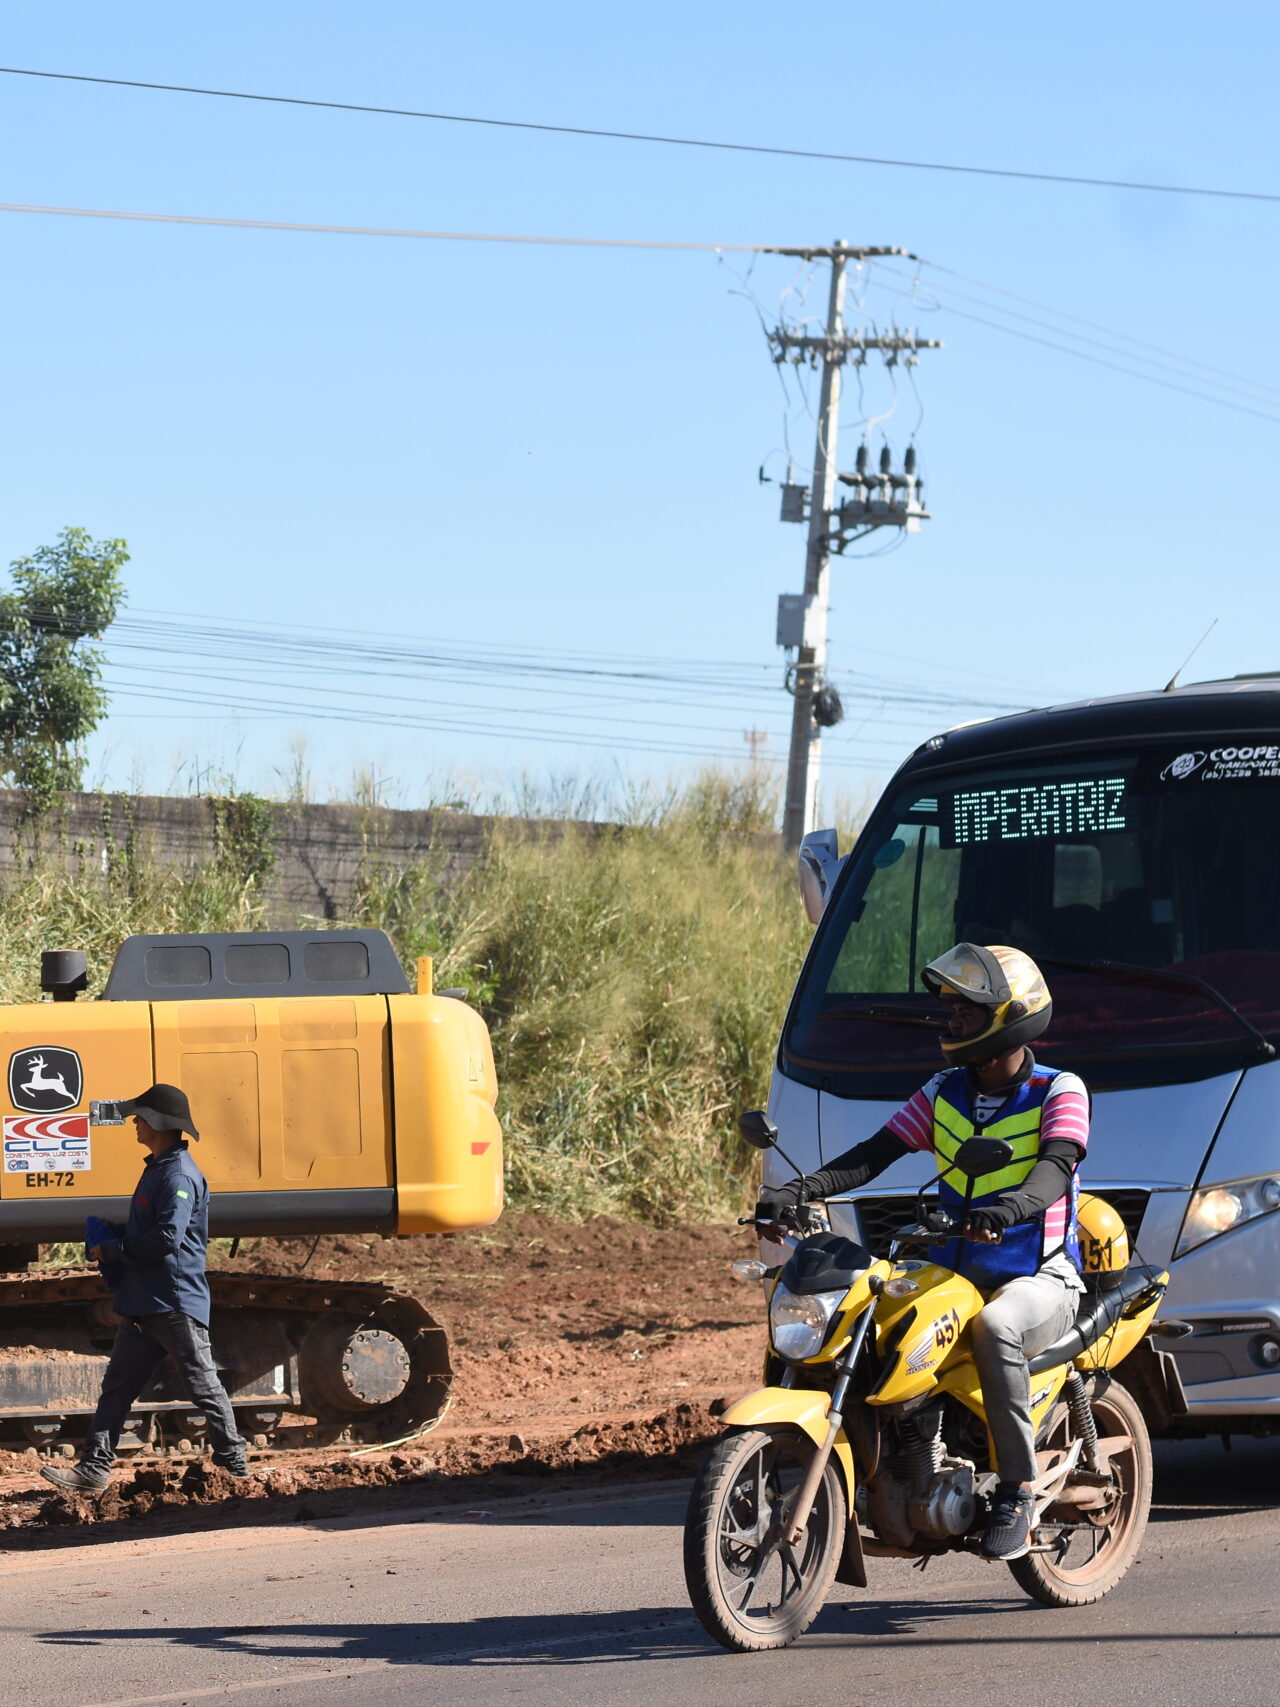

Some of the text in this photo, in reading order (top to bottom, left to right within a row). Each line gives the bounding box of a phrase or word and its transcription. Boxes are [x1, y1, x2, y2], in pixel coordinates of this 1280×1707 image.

[1209, 746, 1280, 761] COOPE
[953, 778, 1125, 843] IMPERATRIZ
[5, 1139, 88, 1152] CLC
[26, 1172, 75, 1188] EH-72
[934, 1307, 961, 1349] 451
[906, 1359, 938, 1376] HONDA
